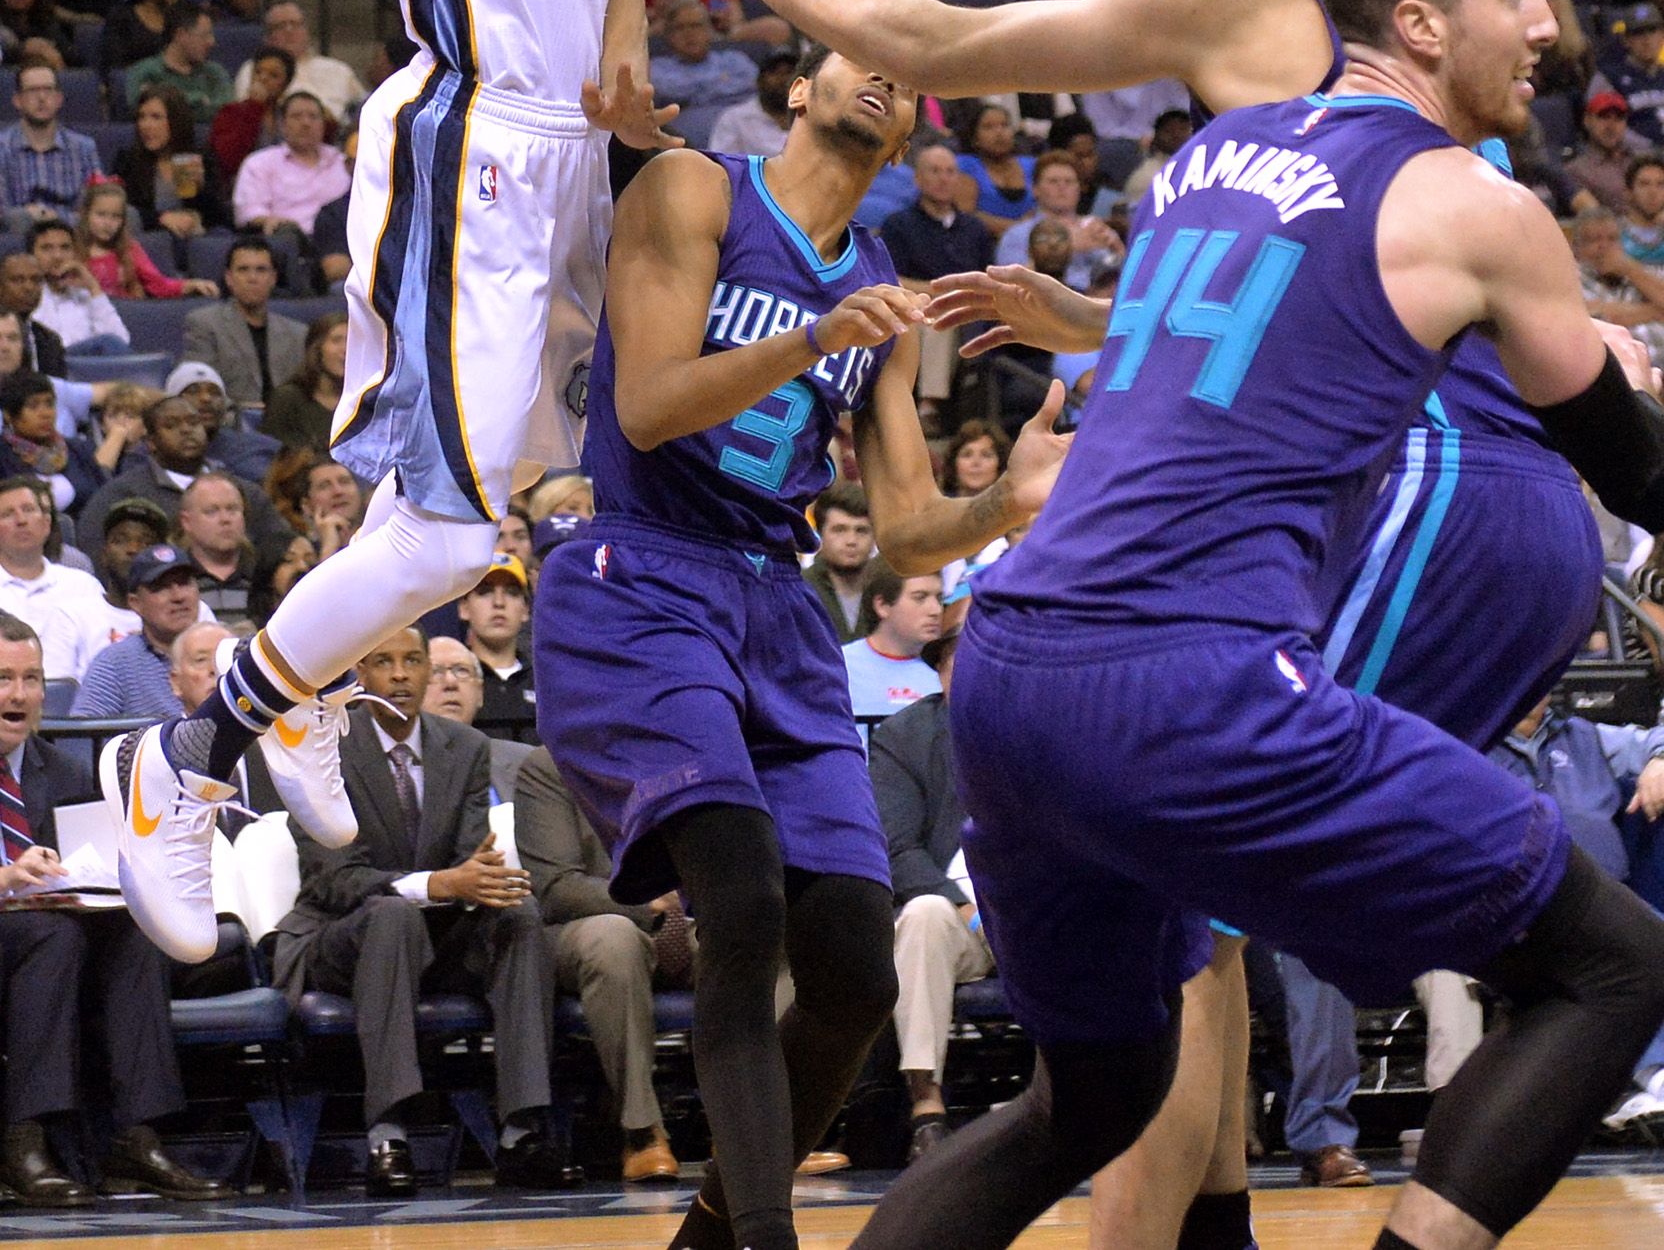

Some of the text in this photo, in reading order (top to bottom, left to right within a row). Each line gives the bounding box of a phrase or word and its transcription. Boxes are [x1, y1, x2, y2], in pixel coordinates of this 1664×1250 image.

[1153, 140, 1345, 224] KAMINSKY
[1105, 228, 1307, 410] 44
[718, 380, 816, 494] 3
